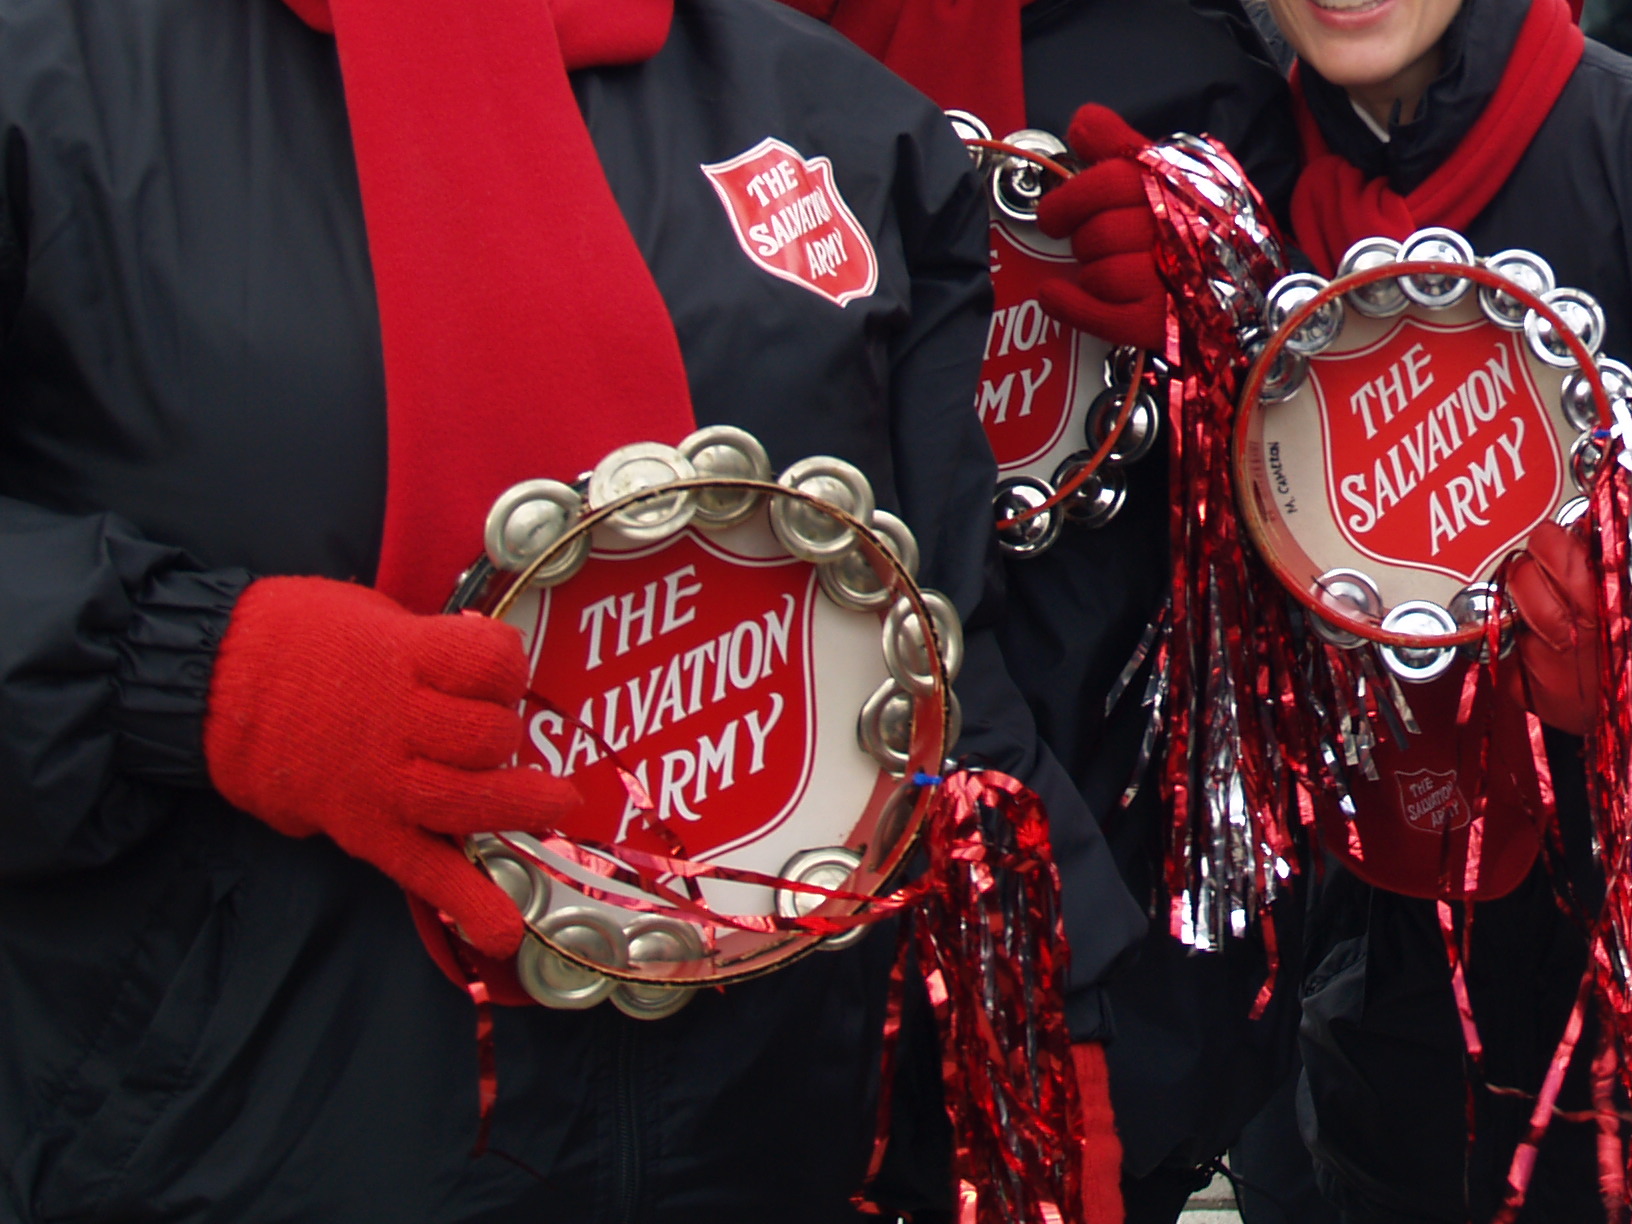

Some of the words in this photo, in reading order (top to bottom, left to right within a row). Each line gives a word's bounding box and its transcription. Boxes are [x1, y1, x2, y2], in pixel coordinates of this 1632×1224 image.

[746, 160, 799, 207] THE
[749, 185, 832, 257] SALVATION
[805, 227, 848, 280] ARMY
[974, 357, 1053, 424] MY
[1350, 342, 1434, 440] THE
[1340, 342, 1516, 533] SALVATION
[1428, 416, 1526, 557] ARMY
[580, 564, 703, 671] THE
[528, 593, 796, 778] SALVATION
[614, 692, 785, 844] ARMY
[1407, 780, 1454, 821] SALVATION
[1409, 776, 1434, 798] THE
